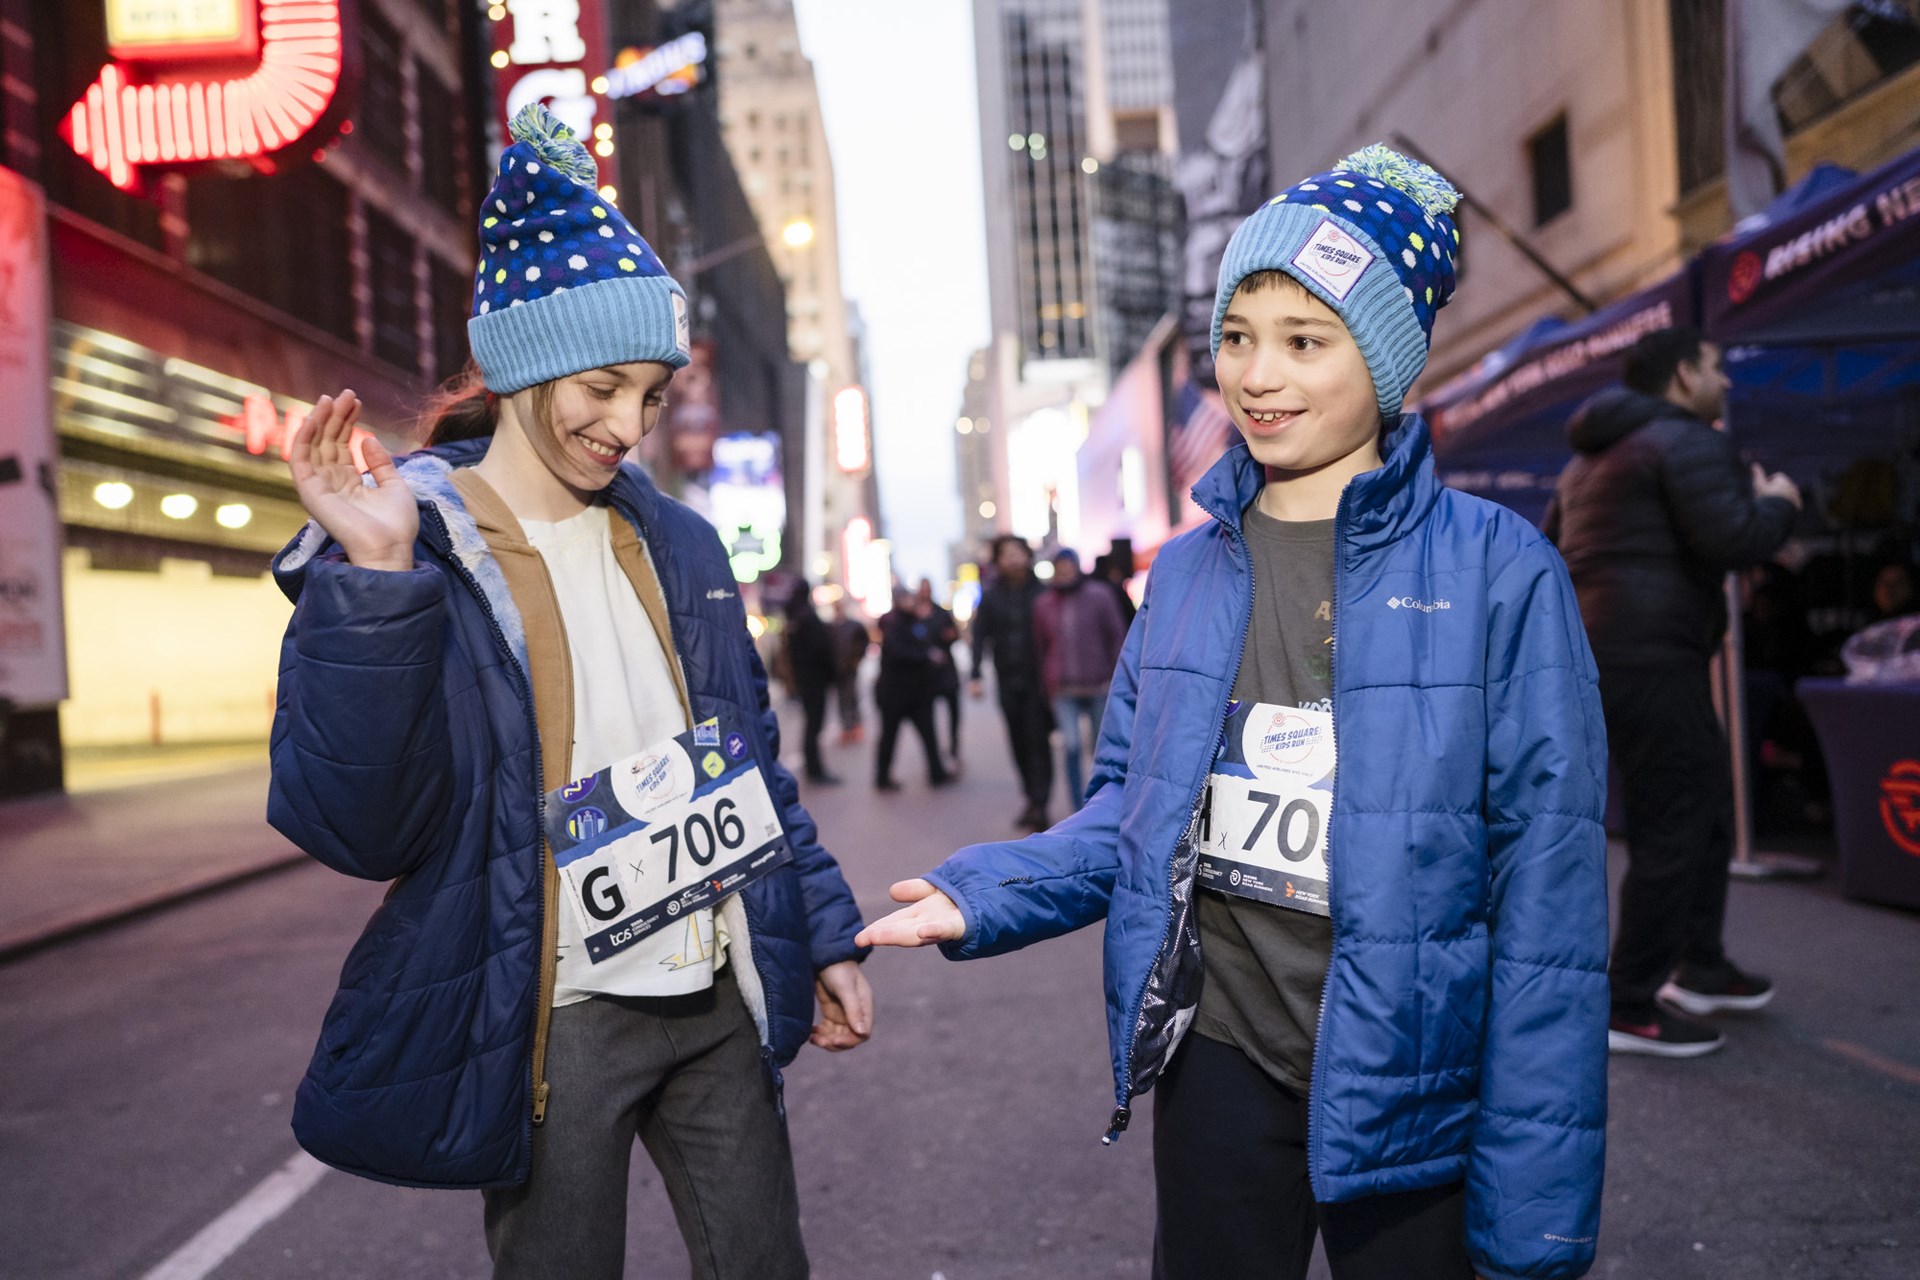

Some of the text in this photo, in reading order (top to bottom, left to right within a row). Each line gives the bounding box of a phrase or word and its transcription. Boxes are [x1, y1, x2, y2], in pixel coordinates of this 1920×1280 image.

[1314, 243, 1361, 263] TIMES SQUARE
[1321, 253, 1335, 262] KIDS
[1264, 726, 1320, 745] TIMES SQUARE
[1275, 739, 1305, 750] KIDS RUN
[636, 754, 670, 793] TIMES SQUARE
[649, 780, 660, 792] KIDS
[1242, 790, 1329, 864] 70
[650, 798, 745, 884] 706
[582, 866, 626, 921] G
[610, 928, 632, 946] tcs
